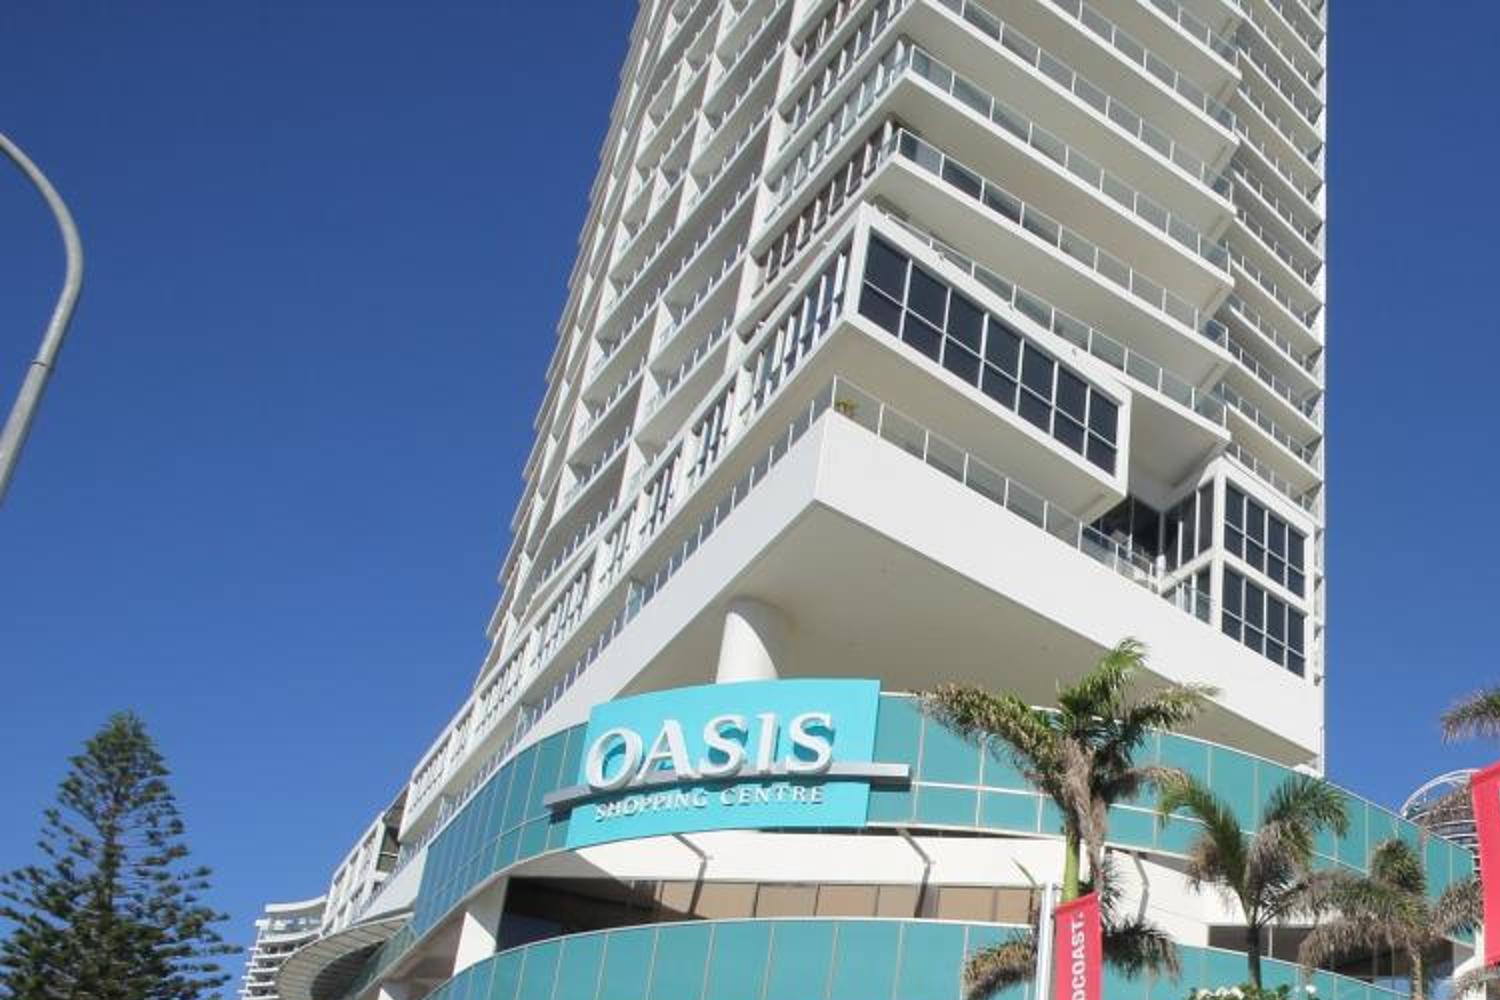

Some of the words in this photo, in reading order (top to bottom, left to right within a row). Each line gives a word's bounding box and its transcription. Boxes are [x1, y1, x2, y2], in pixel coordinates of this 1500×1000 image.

[585, 711, 834, 791] OASIS
[594, 787, 708, 821] SHOPPING
[720, 783, 824, 805] CENTRE
